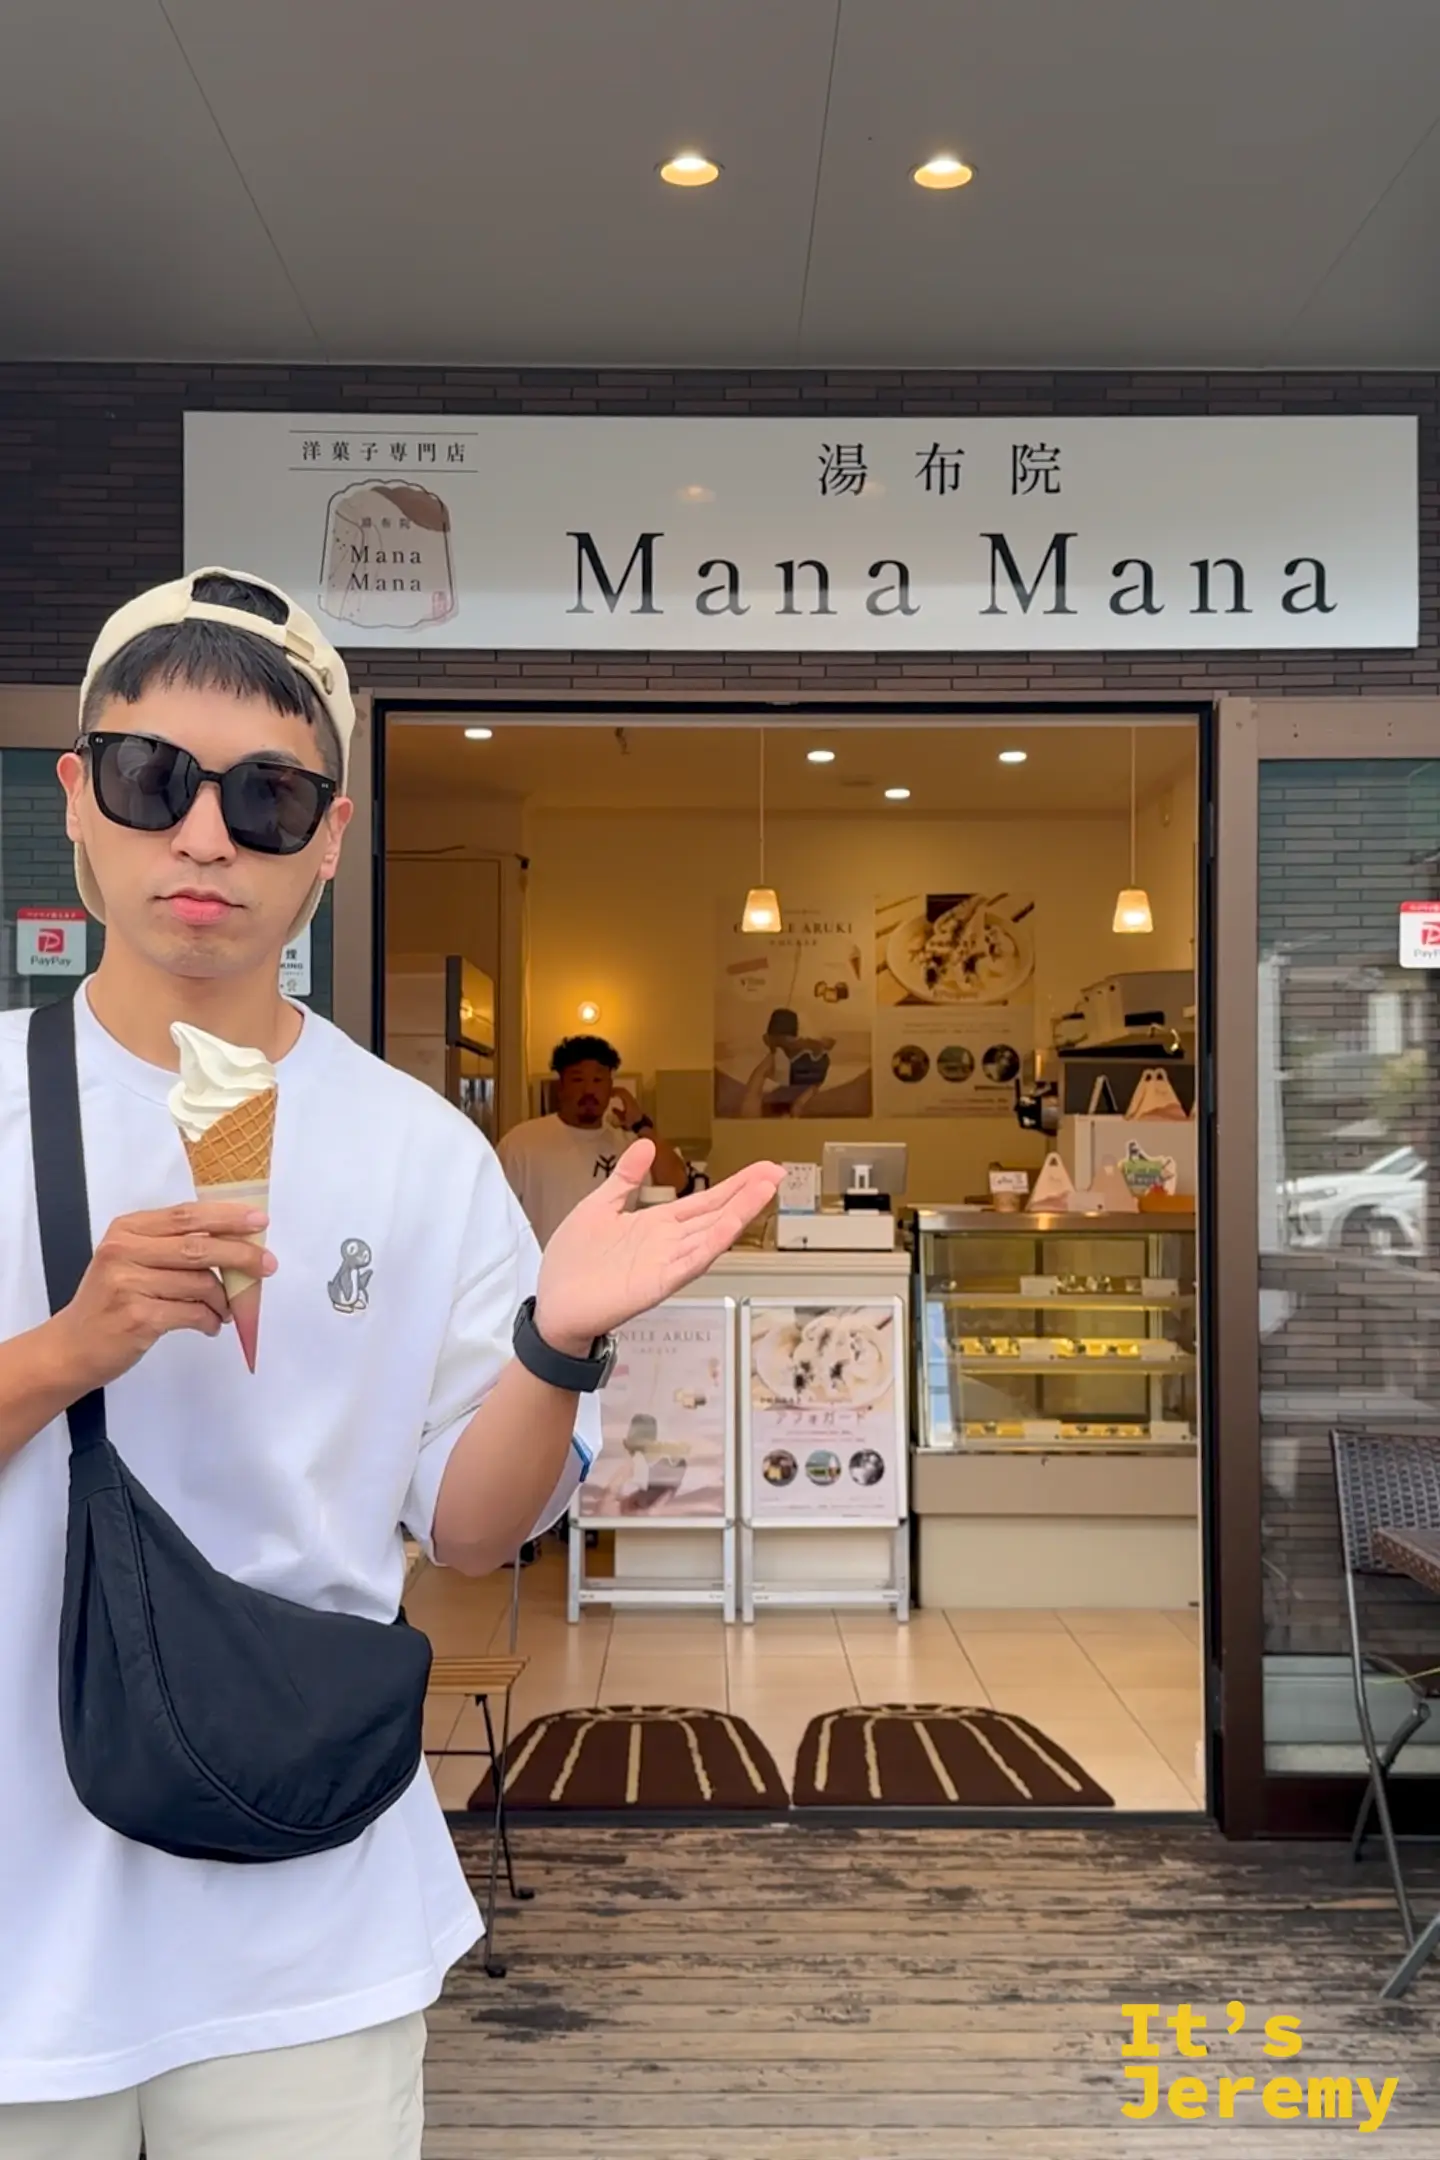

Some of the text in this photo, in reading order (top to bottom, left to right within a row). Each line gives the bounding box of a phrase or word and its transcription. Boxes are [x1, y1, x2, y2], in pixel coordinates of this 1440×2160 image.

[303, 441, 465, 463] 洋菓子専門店
[817, 441, 1061, 496] 湯布院
[350, 544, 422, 565] Mana
[350, 572, 422, 593] Mana
[566, 531, 1338, 617] Mana Mana
[30, 955, 73, 967] PayPay
